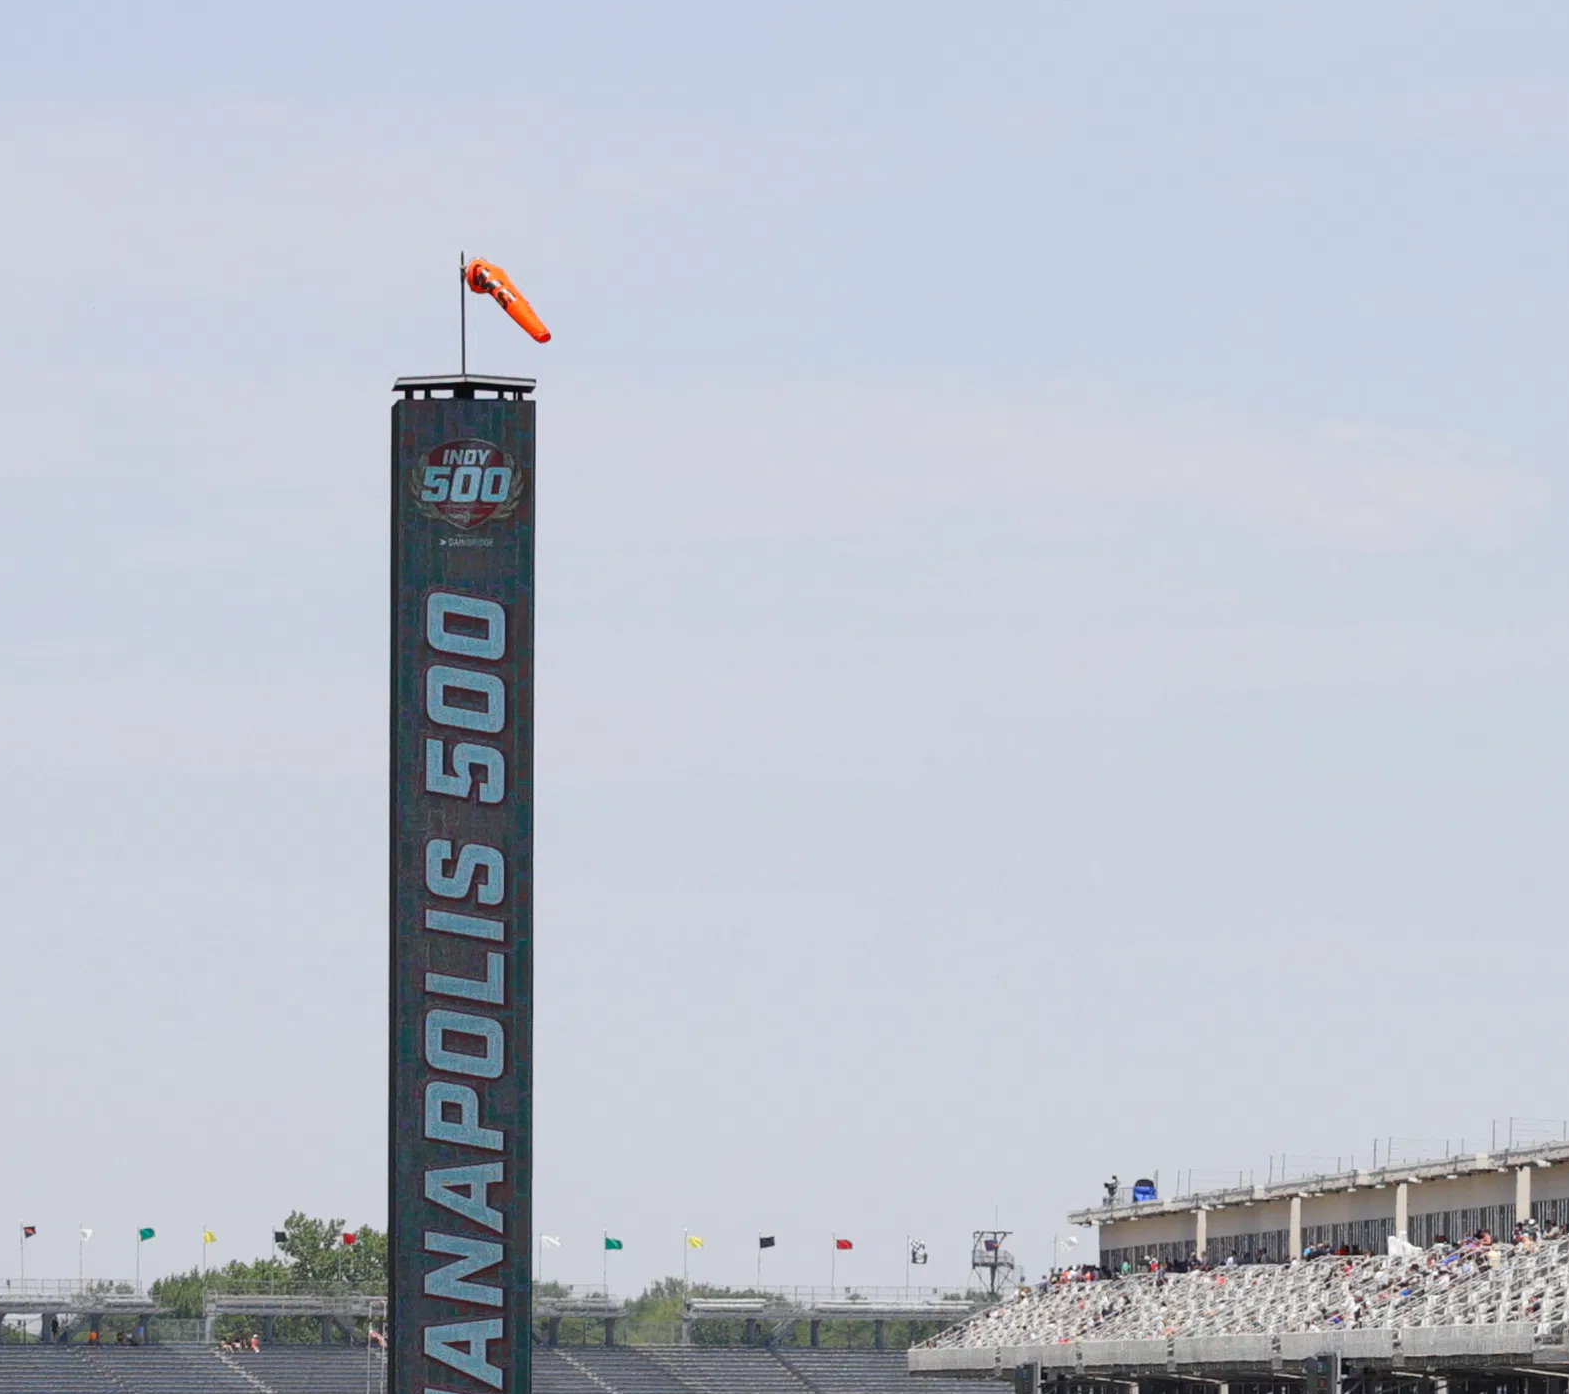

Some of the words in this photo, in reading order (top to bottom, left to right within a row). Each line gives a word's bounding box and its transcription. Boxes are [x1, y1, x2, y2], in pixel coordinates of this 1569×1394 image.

[442, 449, 491, 465] INDY
[421, 466, 512, 502] 500
[425, 591, 507, 806] 500
